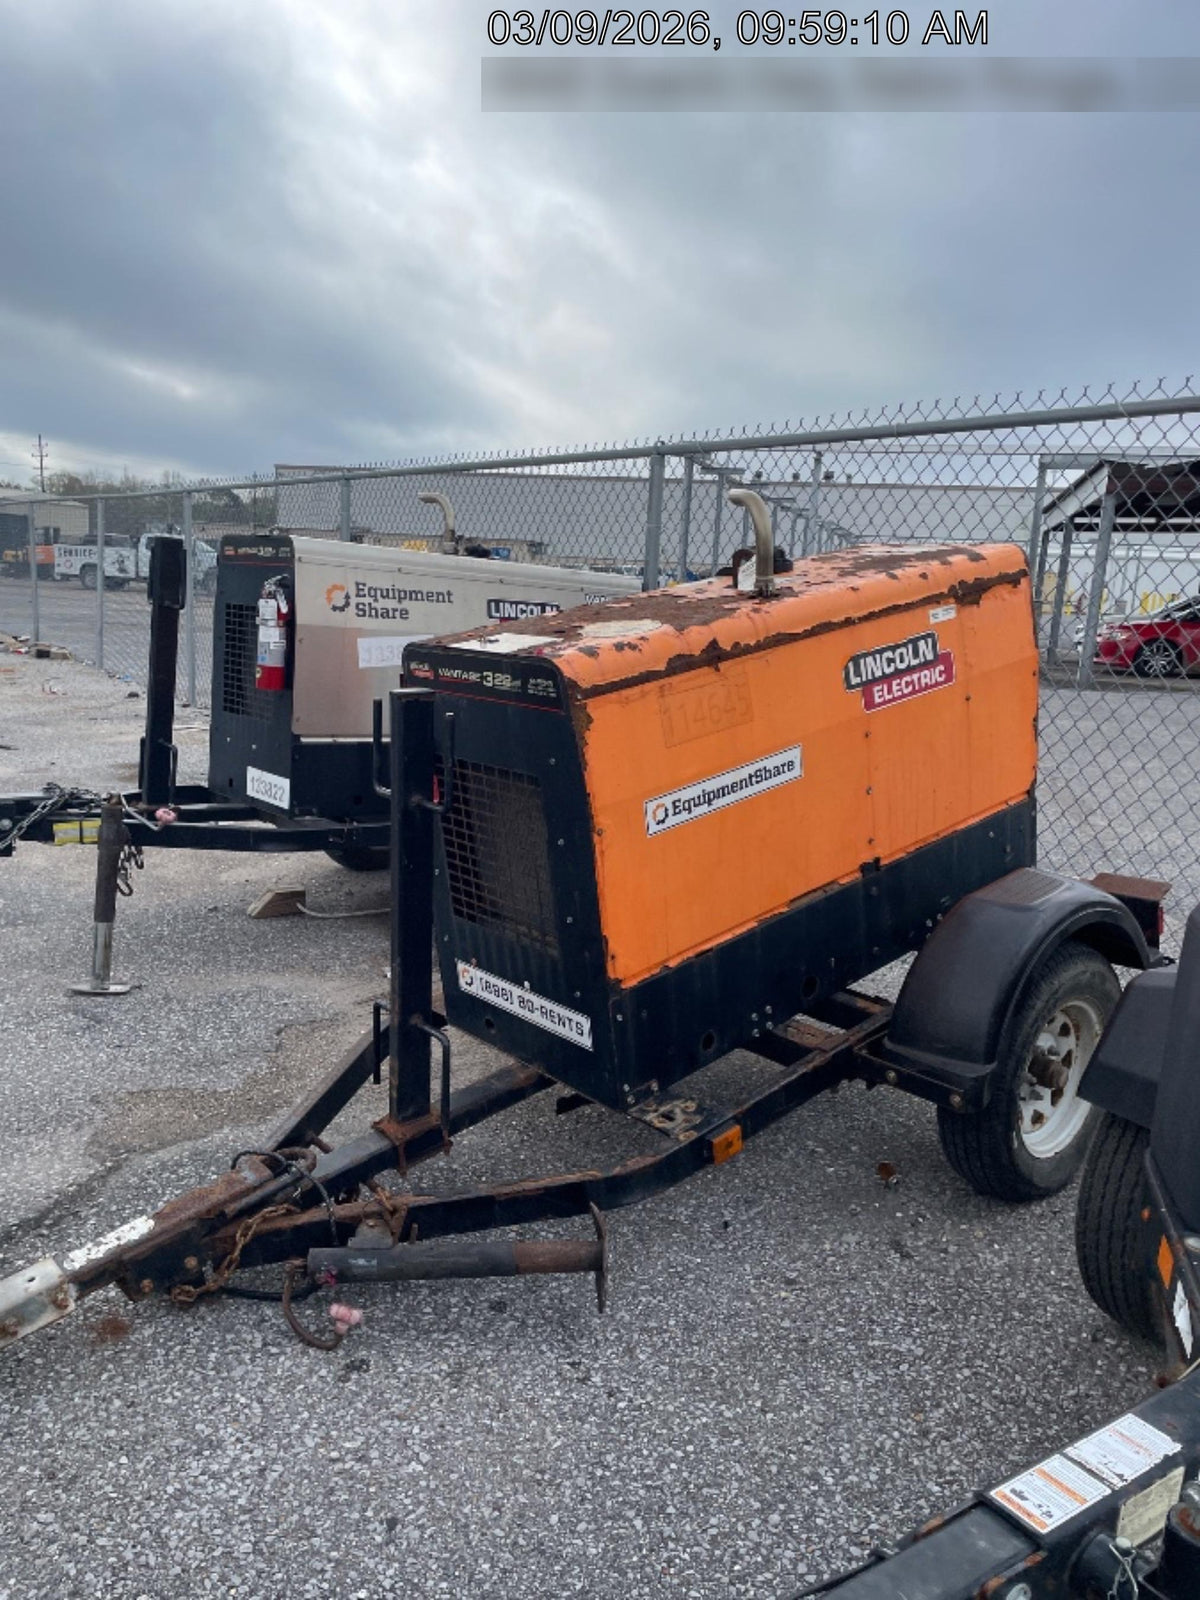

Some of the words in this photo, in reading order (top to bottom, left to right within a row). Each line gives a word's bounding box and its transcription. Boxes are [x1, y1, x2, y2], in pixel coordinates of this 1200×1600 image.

[354, 582, 454, 604] Equipment
[354, 601, 410, 620] Share
[848, 637, 935, 685] LINCOLN
[873, 664, 945, 705] ELECTRIC
[671, 759, 795, 817] EquipmentShare
